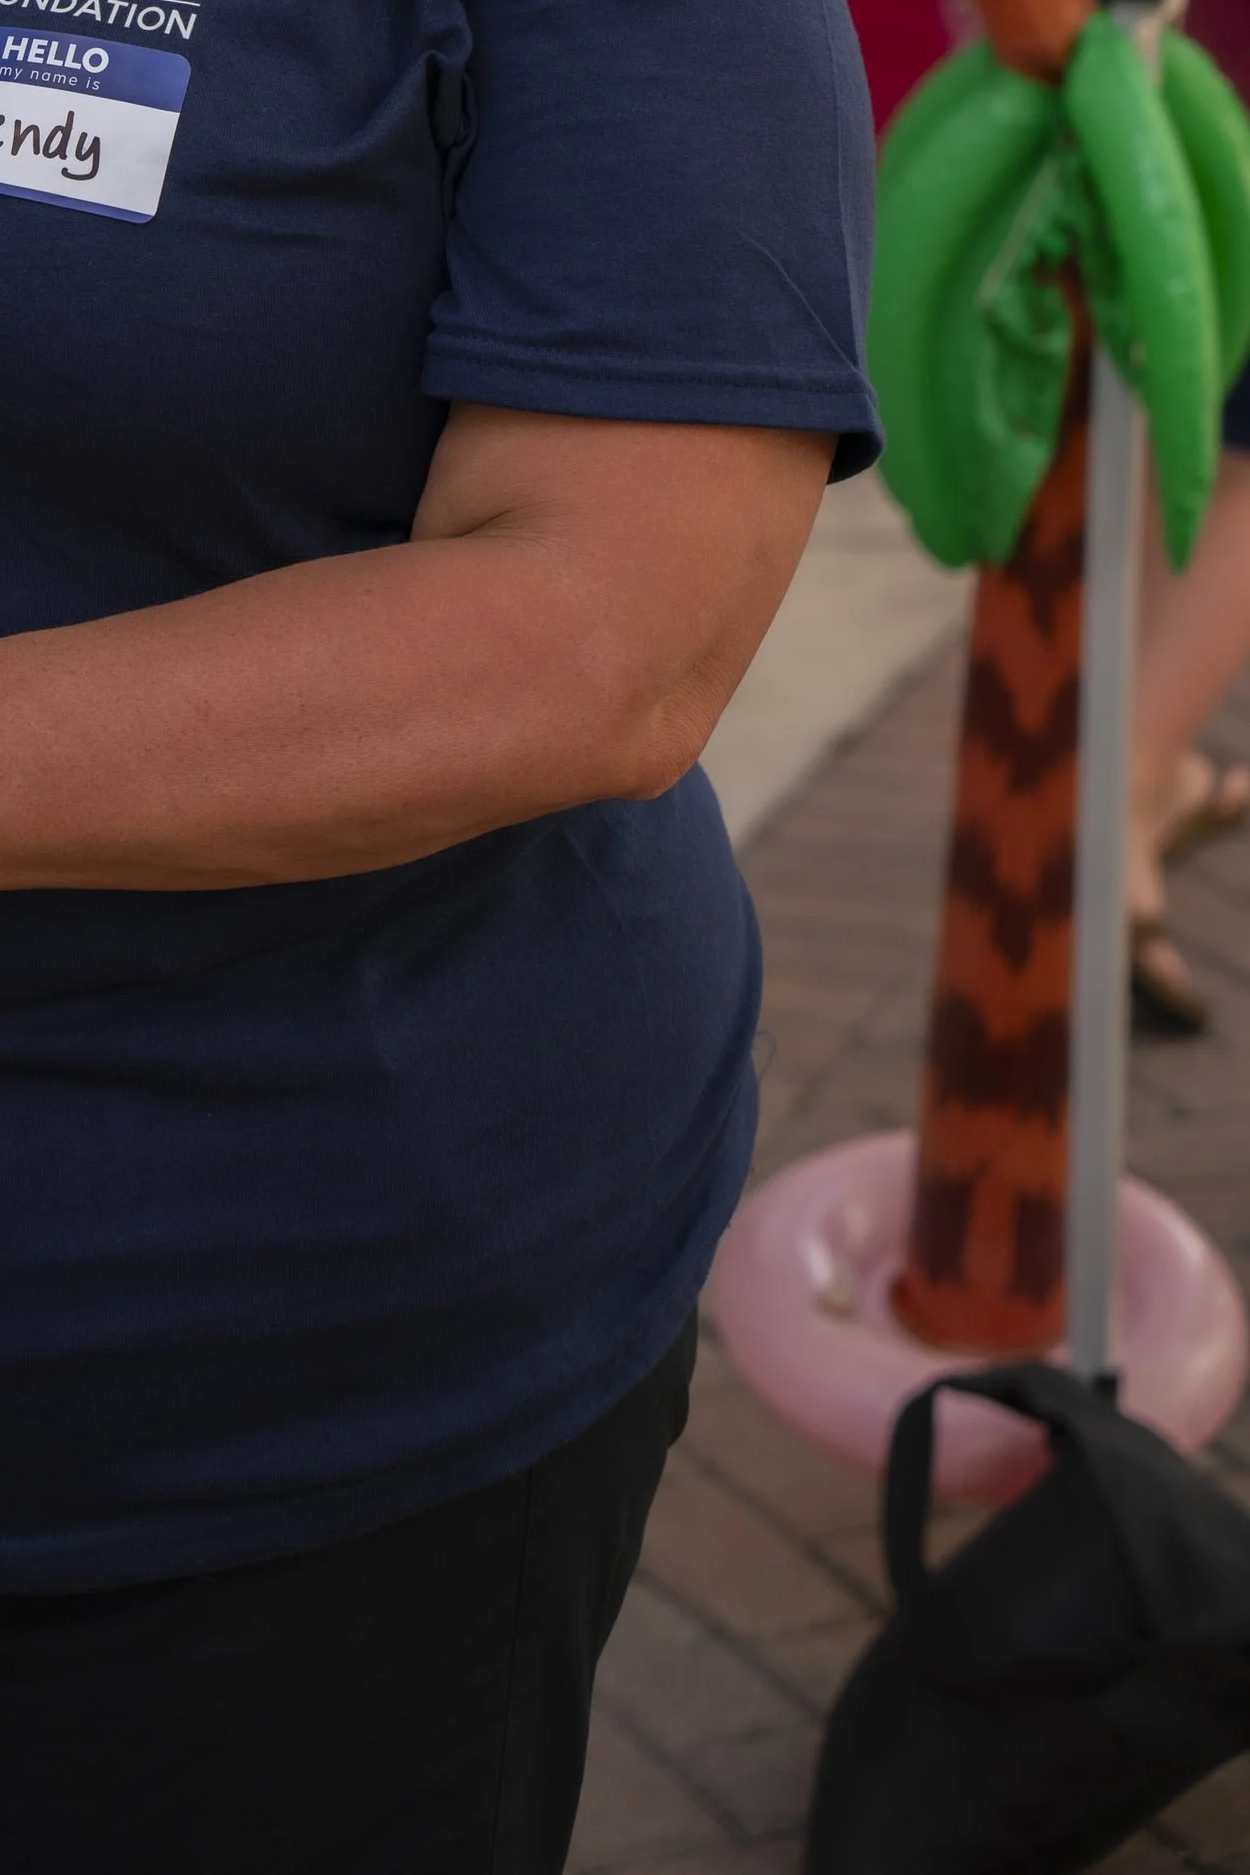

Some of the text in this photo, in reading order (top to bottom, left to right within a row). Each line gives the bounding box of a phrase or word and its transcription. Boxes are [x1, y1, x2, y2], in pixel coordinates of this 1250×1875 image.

[2, 36, 110, 74] HELLO
[30, 69, 78, 87] name
[86, 77, 101, 91] is
